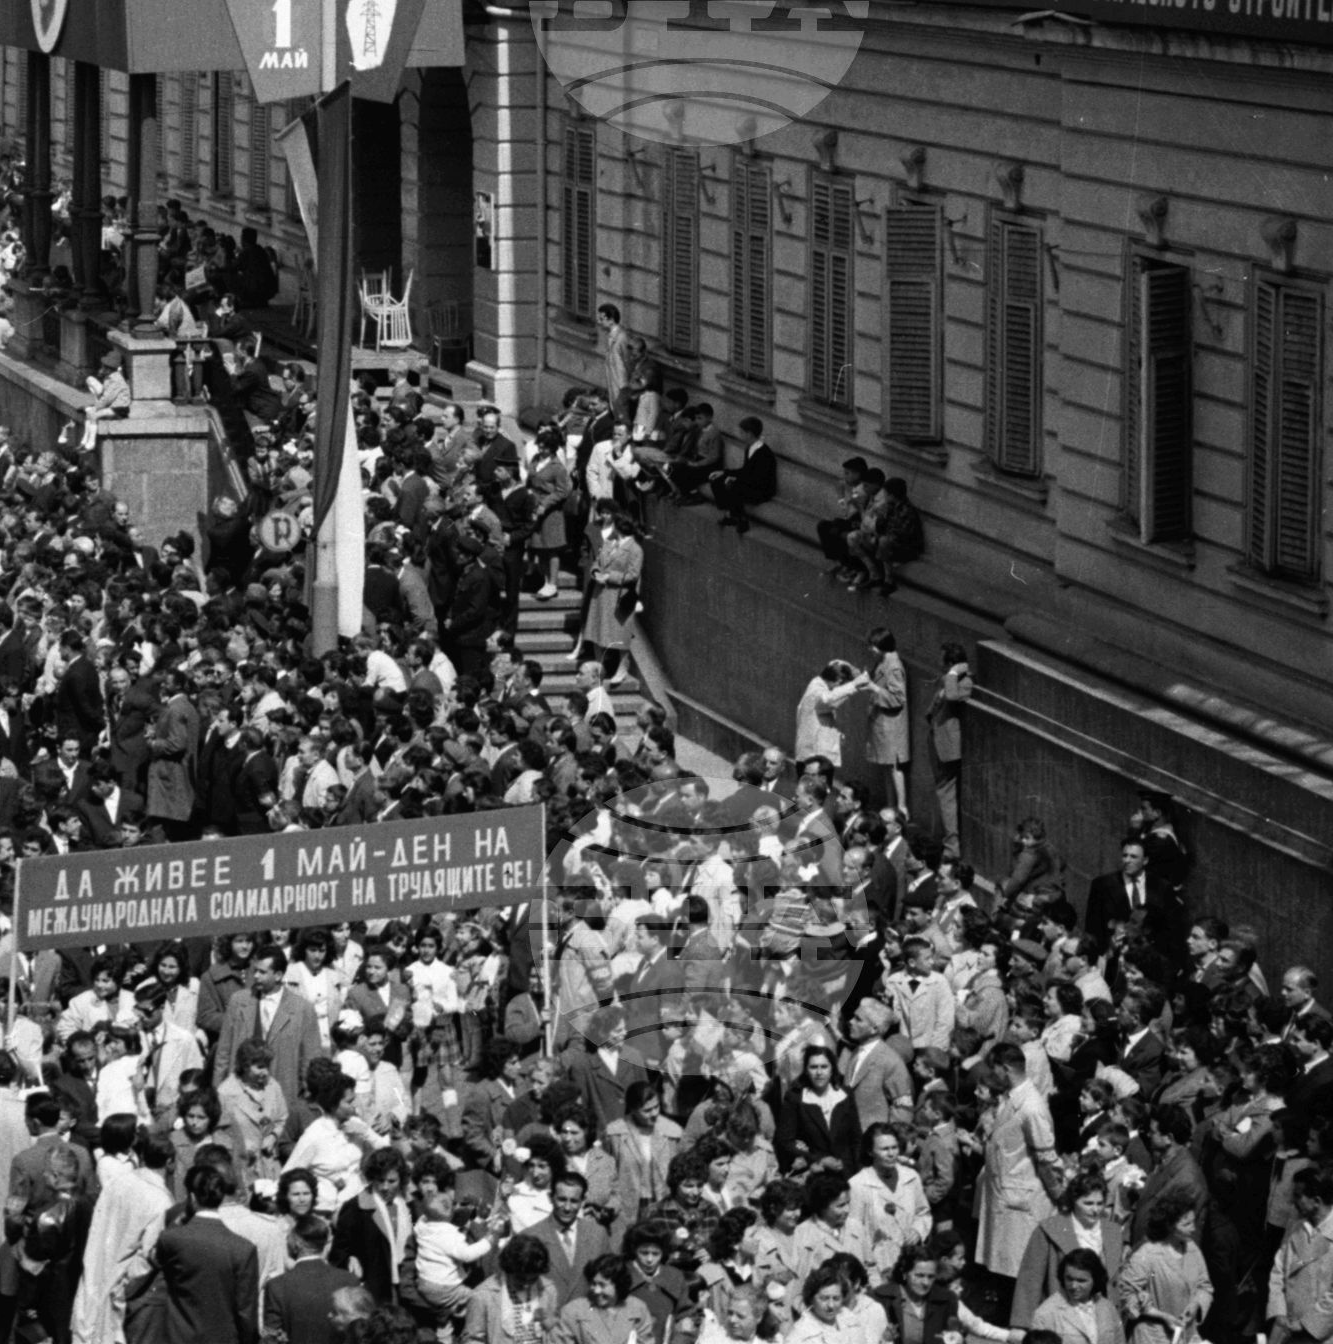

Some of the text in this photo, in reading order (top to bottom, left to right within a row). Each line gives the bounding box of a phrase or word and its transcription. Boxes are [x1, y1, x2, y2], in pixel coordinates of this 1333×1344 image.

[258, 48, 309, 69] МАЙ
[27, 859, 532, 938] МЕЖДУНАРОДНАТА СОЛИДАРНОСТ НА ТРУДЯЩИТЕ СЕ!
[54, 825, 511, 901] ДА ЖИВЕЕ 1 МАЙ-ДЕН НА
